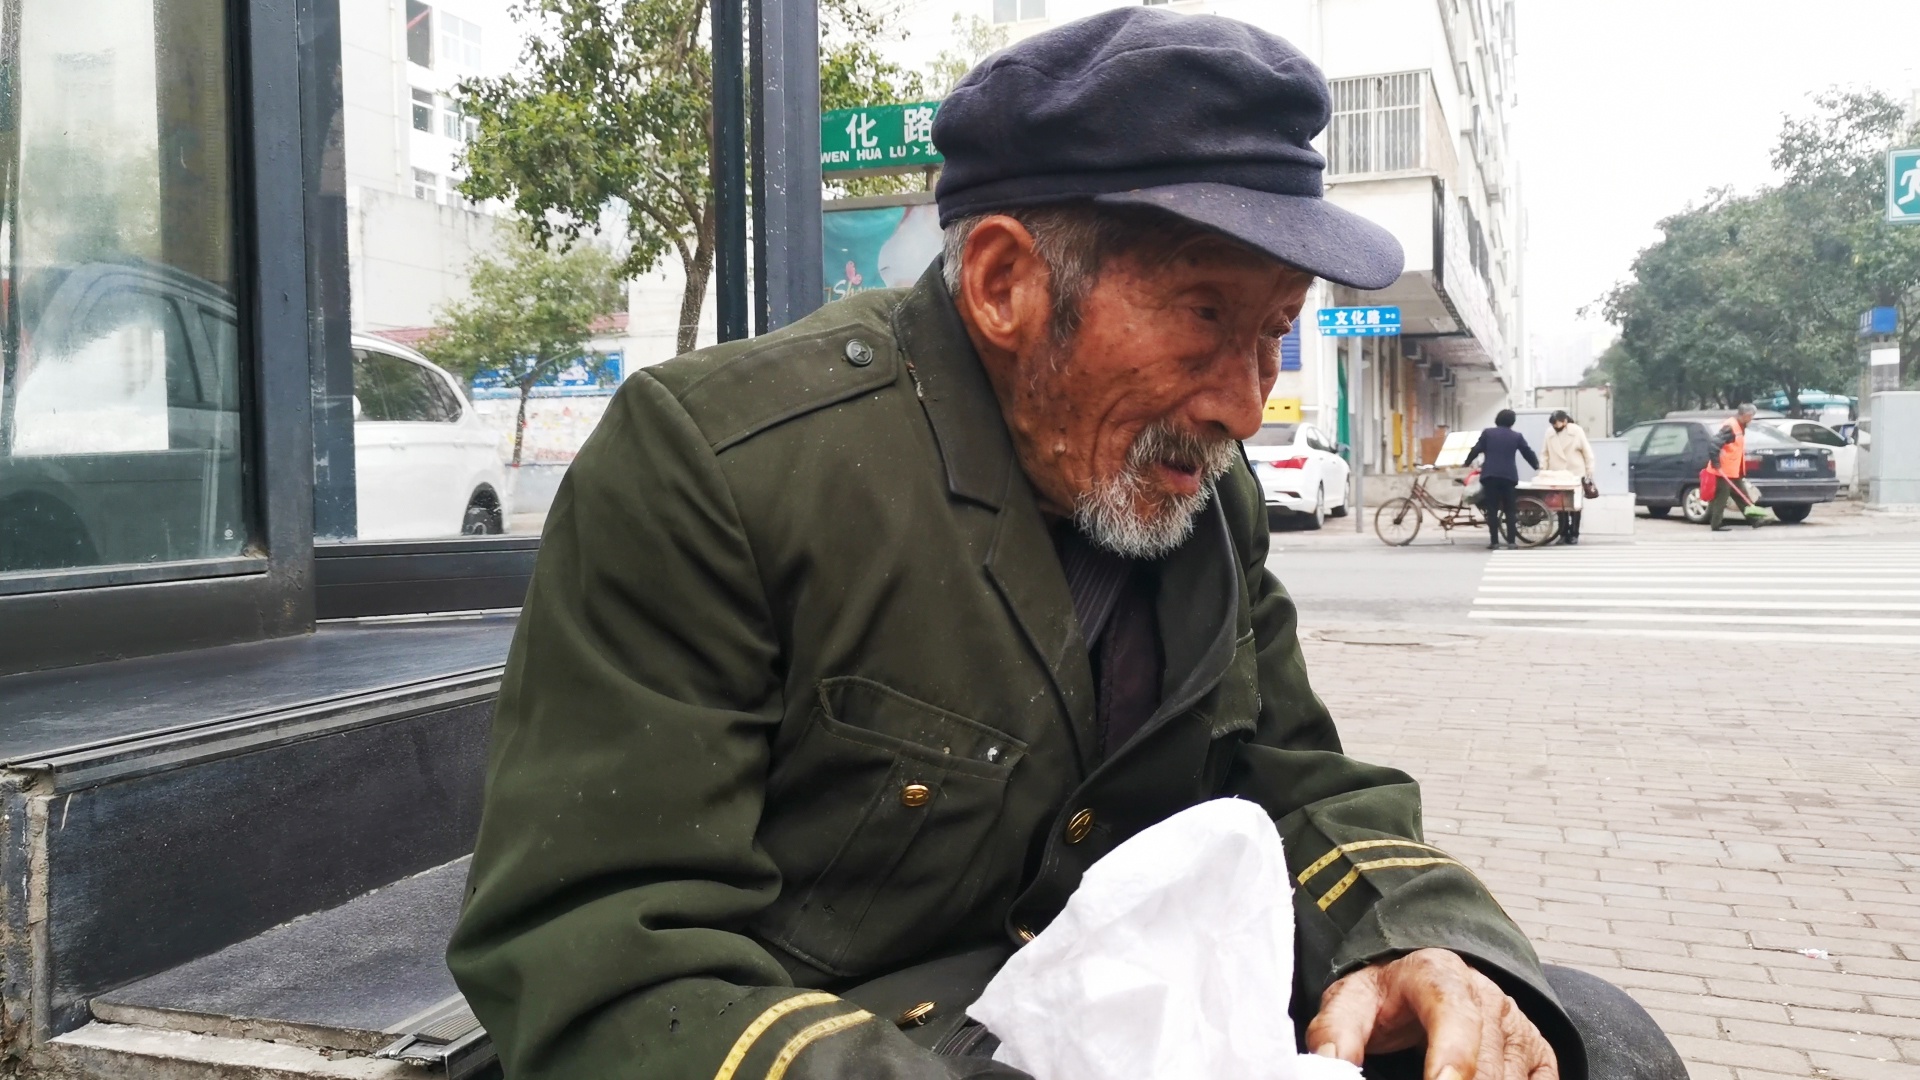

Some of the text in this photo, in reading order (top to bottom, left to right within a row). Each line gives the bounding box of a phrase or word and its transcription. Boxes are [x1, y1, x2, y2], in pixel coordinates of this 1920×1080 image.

[820, 145, 906, 163] WEN HUA LU
[1335, 310, 1380, 325] 文化路
